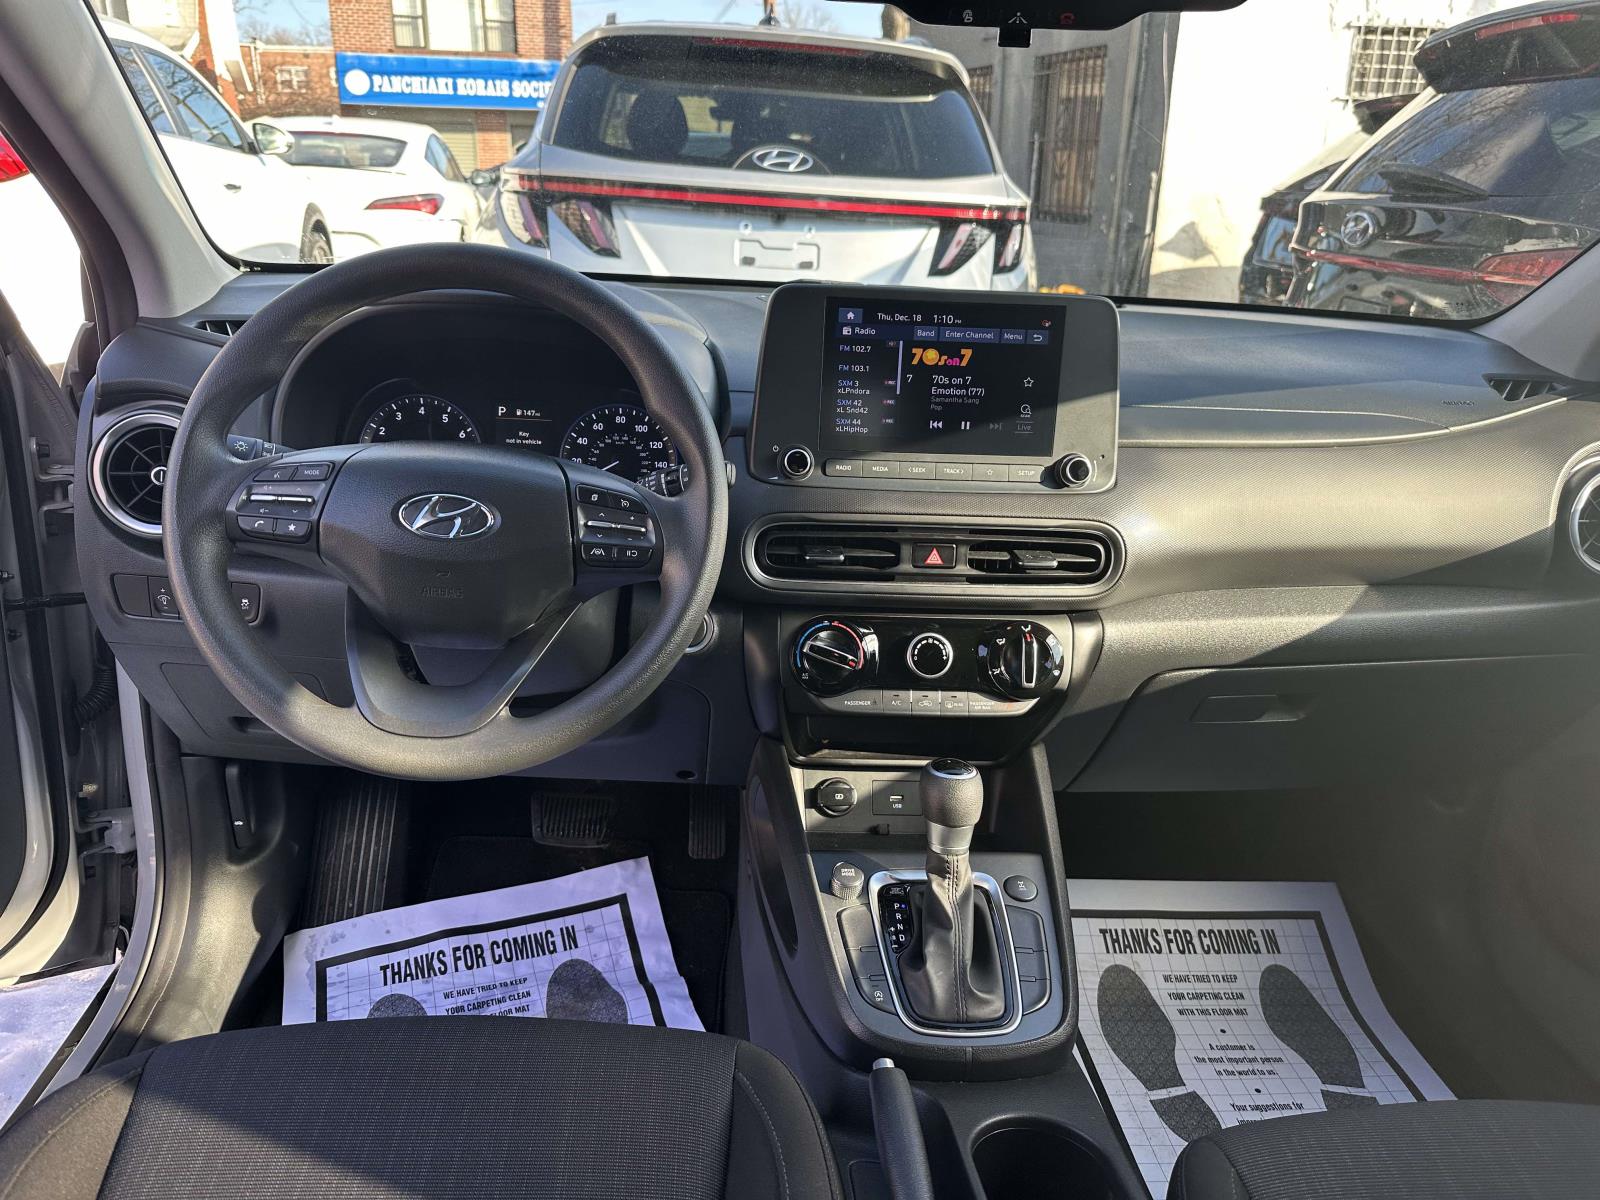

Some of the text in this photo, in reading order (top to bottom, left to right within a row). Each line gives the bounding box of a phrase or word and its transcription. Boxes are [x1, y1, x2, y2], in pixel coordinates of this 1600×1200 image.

[372, 74, 454, 95] PANCHIAKI
[456, 77, 510, 97] KORAIS
[912, 314, 921, 322] 18
[933, 314, 954, 324] 1:10
[854, 327, 876, 335] Radio
[945, 330, 994, 339] Enter Channel
[851, 345, 871, 353] 102.7
[906, 374, 913, 383] 7
[932, 375, 972, 385] 70s on 7
[837, 387, 870, 395] xLPndora
[931, 386, 985, 397] Emotion (77)
[852, 399, 863, 407] 42
[418, 406, 425, 415] 4
[498, 406, 507, 417] P
[395, 412, 402, 421] 3
[442, 414, 449, 423] 5
[615, 416, 626, 424] 80
[379, 426, 386, 435] 2
[592, 422, 604, 431] 60
[634, 425, 649, 433] 100
[835, 425, 869, 433] xLHipHop
[459, 430, 466, 439] 6
[576, 437, 588, 445] 40
[649, 441, 663, 449] 120
[654, 461, 668, 469] 140
[894, 902, 900, 910] P
[899, 934, 905, 942] D
[1098, 927, 1281, 955] THANKS FOR COMING IN
[379, 924, 579, 986] THANKS FOR COMING IN
[1162, 974, 1238, 983] WE HAVE TRIED TO KEEP
[443, 991, 455, 1000] WE
[456, 987, 476, 997] HAVE
[476, 983, 497, 993] TRIED
[509, 977, 528, 986] KEEP
[1167, 991, 1245, 1001] YOUR CARPETING CLEAN
[445, 989, 531, 1016] YOUR CARPETING CLEAN
[514, 1004, 530, 1014] MAT
[1176, 1008, 1249, 1016] WITH THIS FLOOR MAT
[1208, 1043, 1256, 1051] A customer is
[1193, 1056, 1284, 1065] the most important person
[1223, 1068, 1237, 1076] the
[1236, 1068, 1257, 1076] world
[1256, 1068, 1267, 1076] to
[1230, 1101, 1305, 1113] Your suggestions for
